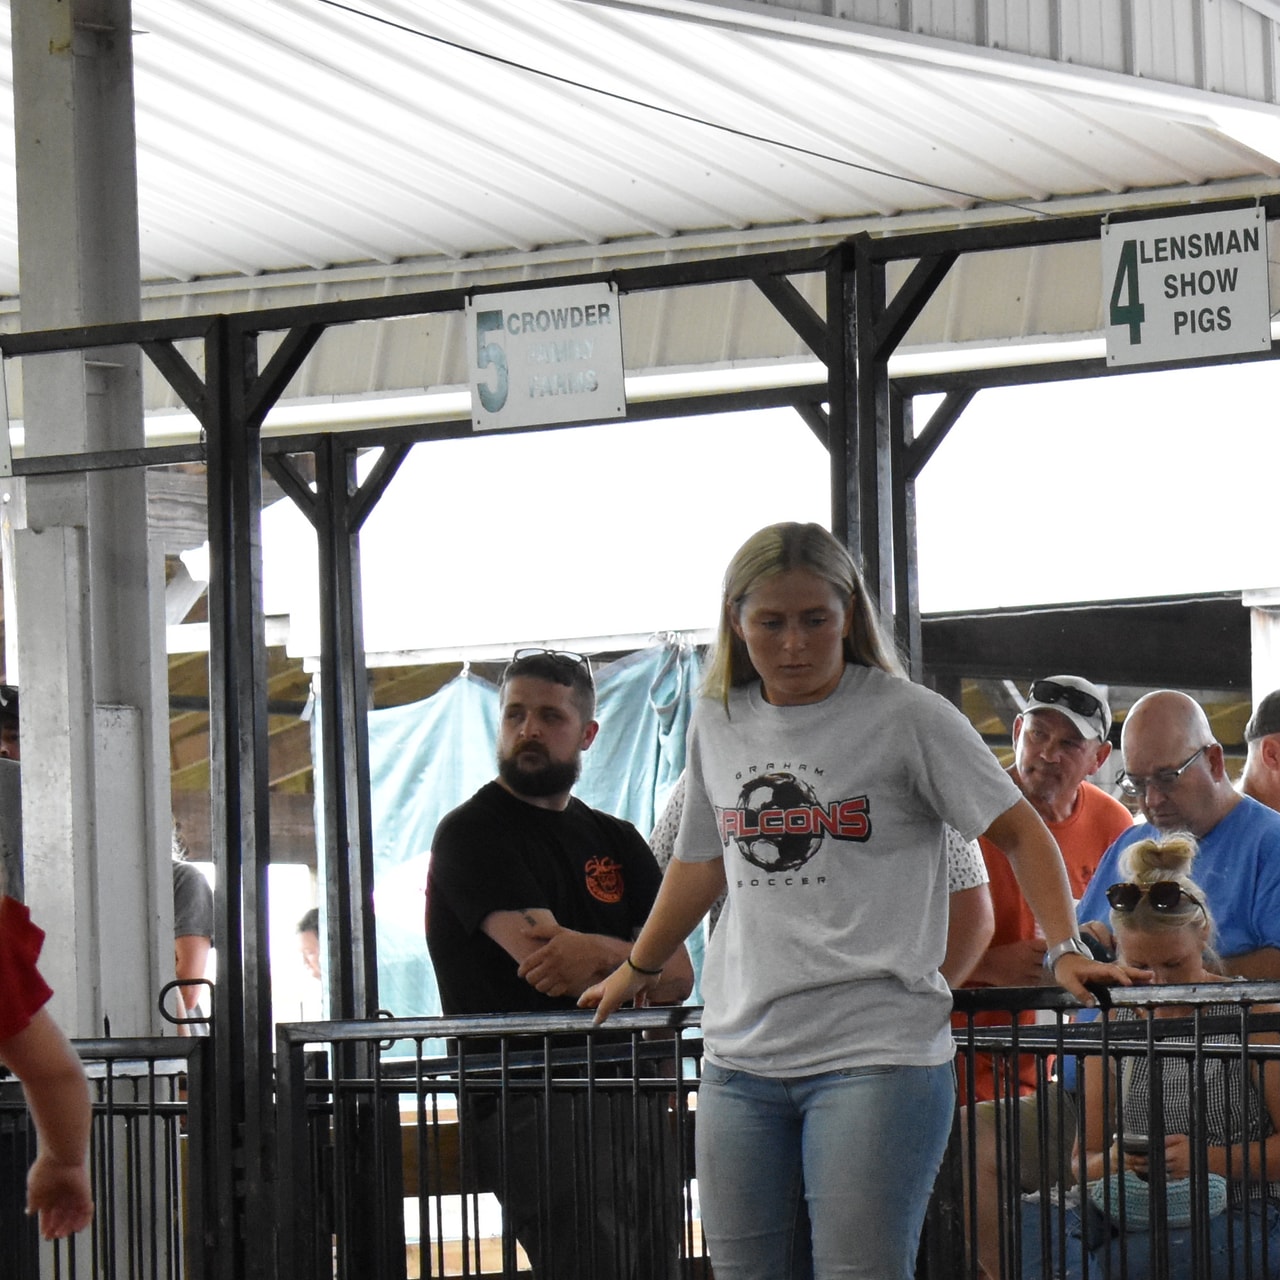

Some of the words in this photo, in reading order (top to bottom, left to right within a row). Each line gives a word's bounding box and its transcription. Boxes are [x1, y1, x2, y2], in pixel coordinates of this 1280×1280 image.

[1140, 227, 1259, 264] LENSMAN
[1110, 239, 1145, 346] 4
[1164, 268, 1238, 299] SHOW
[506, 303, 612, 335] CROWDER
[1174, 306, 1231, 336] PIGS
[476, 309, 509, 413] 5
[735, 762, 825, 780] GRAHAM
[737, 876, 826, 888] SOCCER
